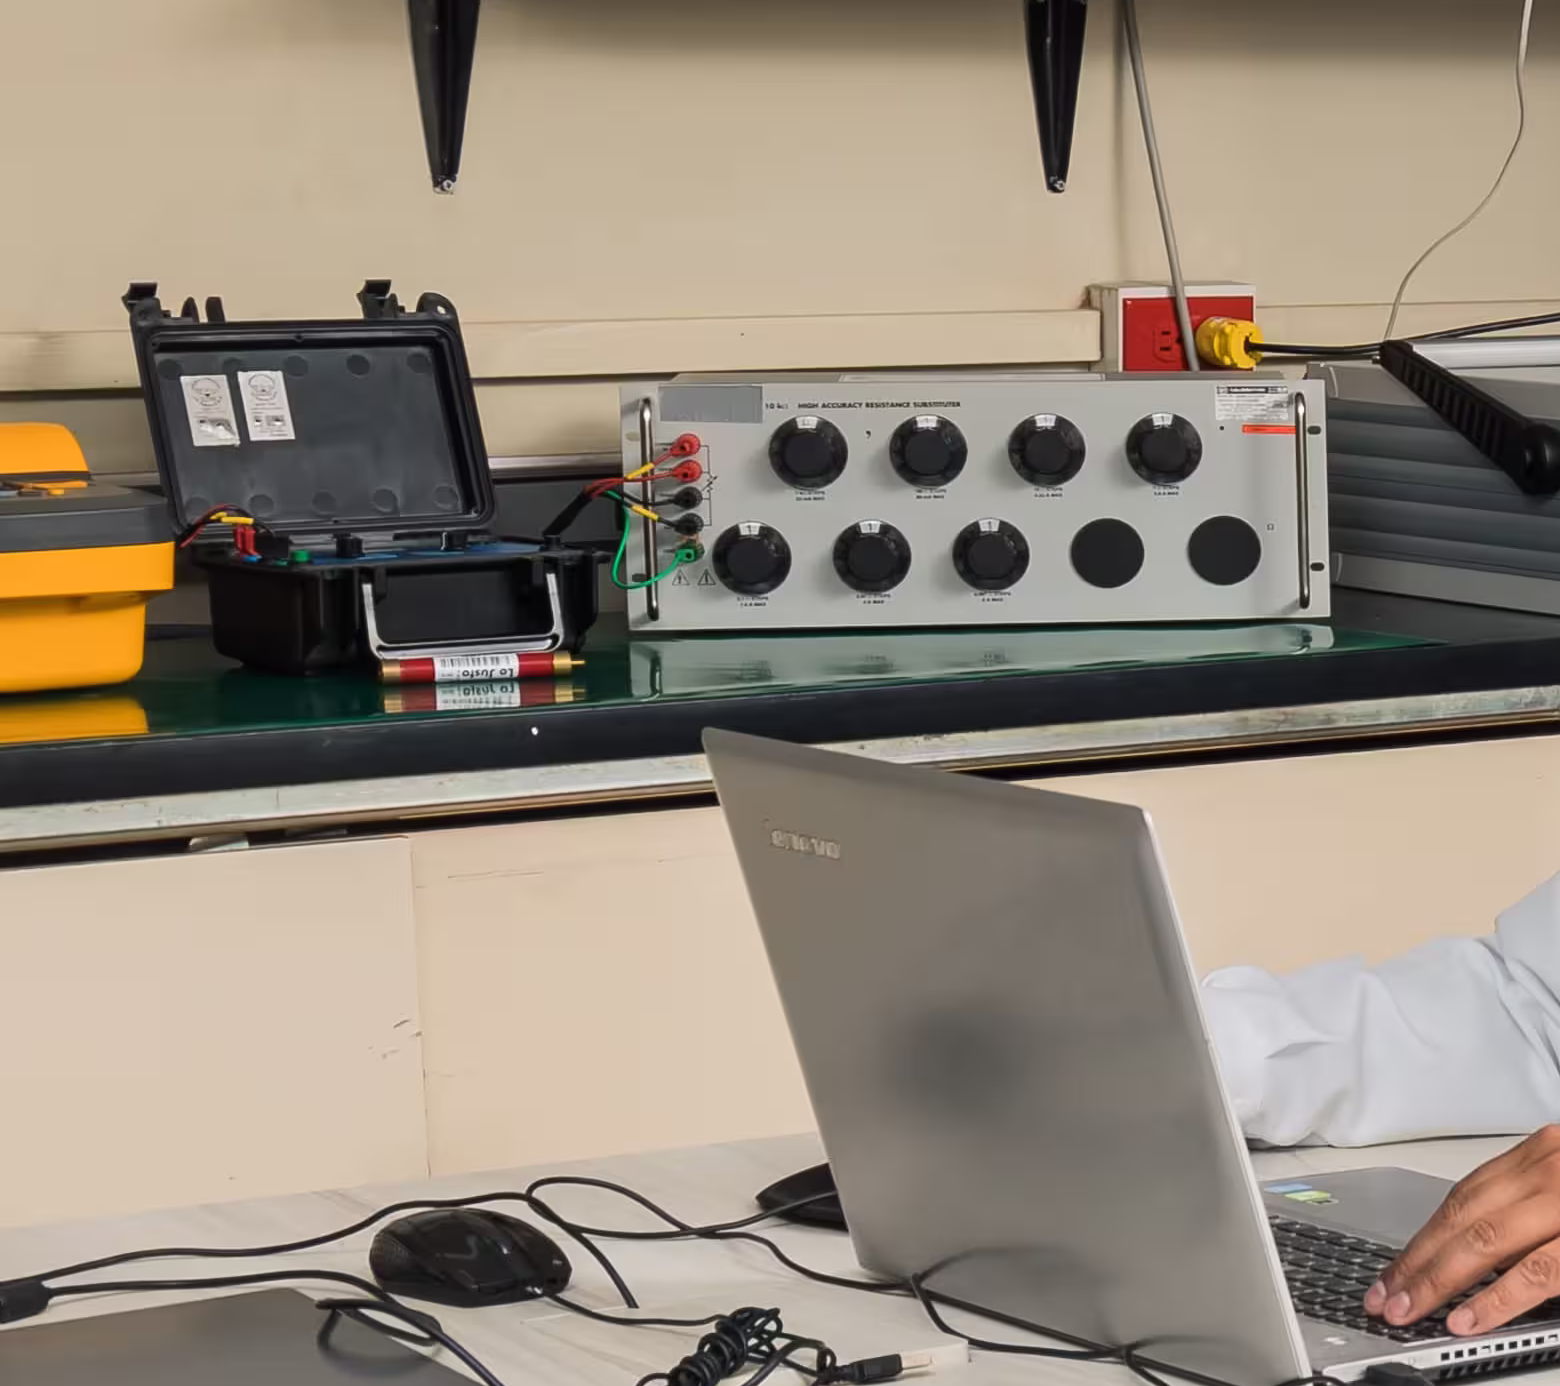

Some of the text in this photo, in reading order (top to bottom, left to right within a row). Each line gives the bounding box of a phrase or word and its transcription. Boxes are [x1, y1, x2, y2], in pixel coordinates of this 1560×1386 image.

[821, 401, 863, 409] ACCURACY
[865, 401, 911, 409] RESISTANCE
[462, 668, 515, 680] Lo Justo
